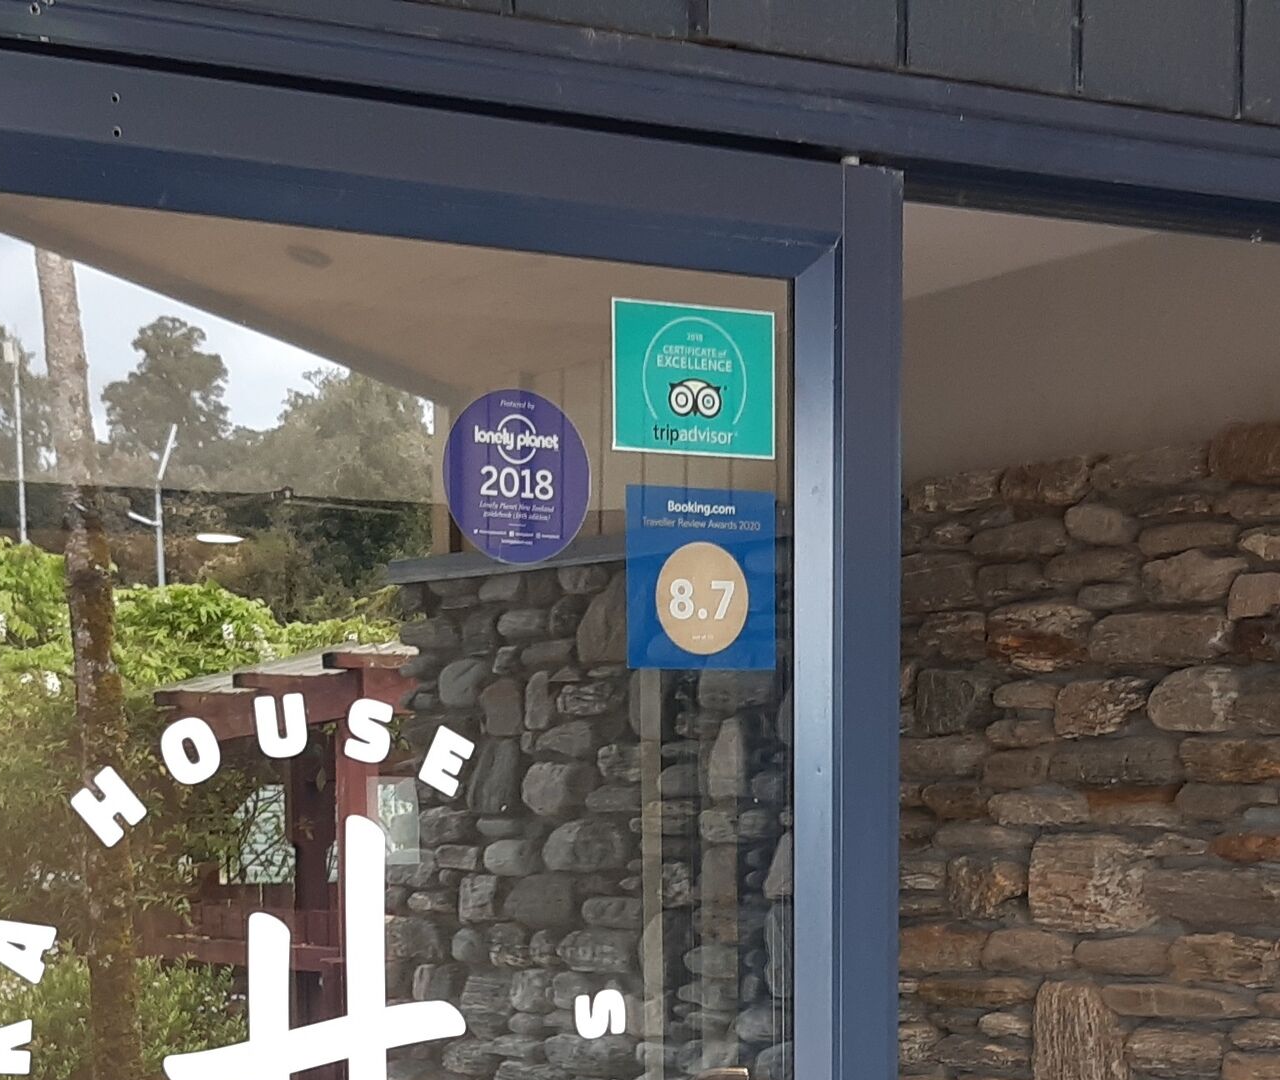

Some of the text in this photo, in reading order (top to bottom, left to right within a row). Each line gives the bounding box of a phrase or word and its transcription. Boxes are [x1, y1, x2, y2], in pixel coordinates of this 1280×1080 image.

[663, 345, 726, 358] CERTIFICATE of
[657, 355, 733, 372] EXCELLENCE
[474, 425, 559, 451] lonely planet
[653, 424, 734, 445] tripadvisor
[480, 465, 554, 501] 2018
[667, 500, 736, 516] Booking.com
[642, 516, 761, 531] Traveller Review Awards 2020
[669, 578, 735, 620] 8.7
[70, 693, 476, 848] HOUSE
